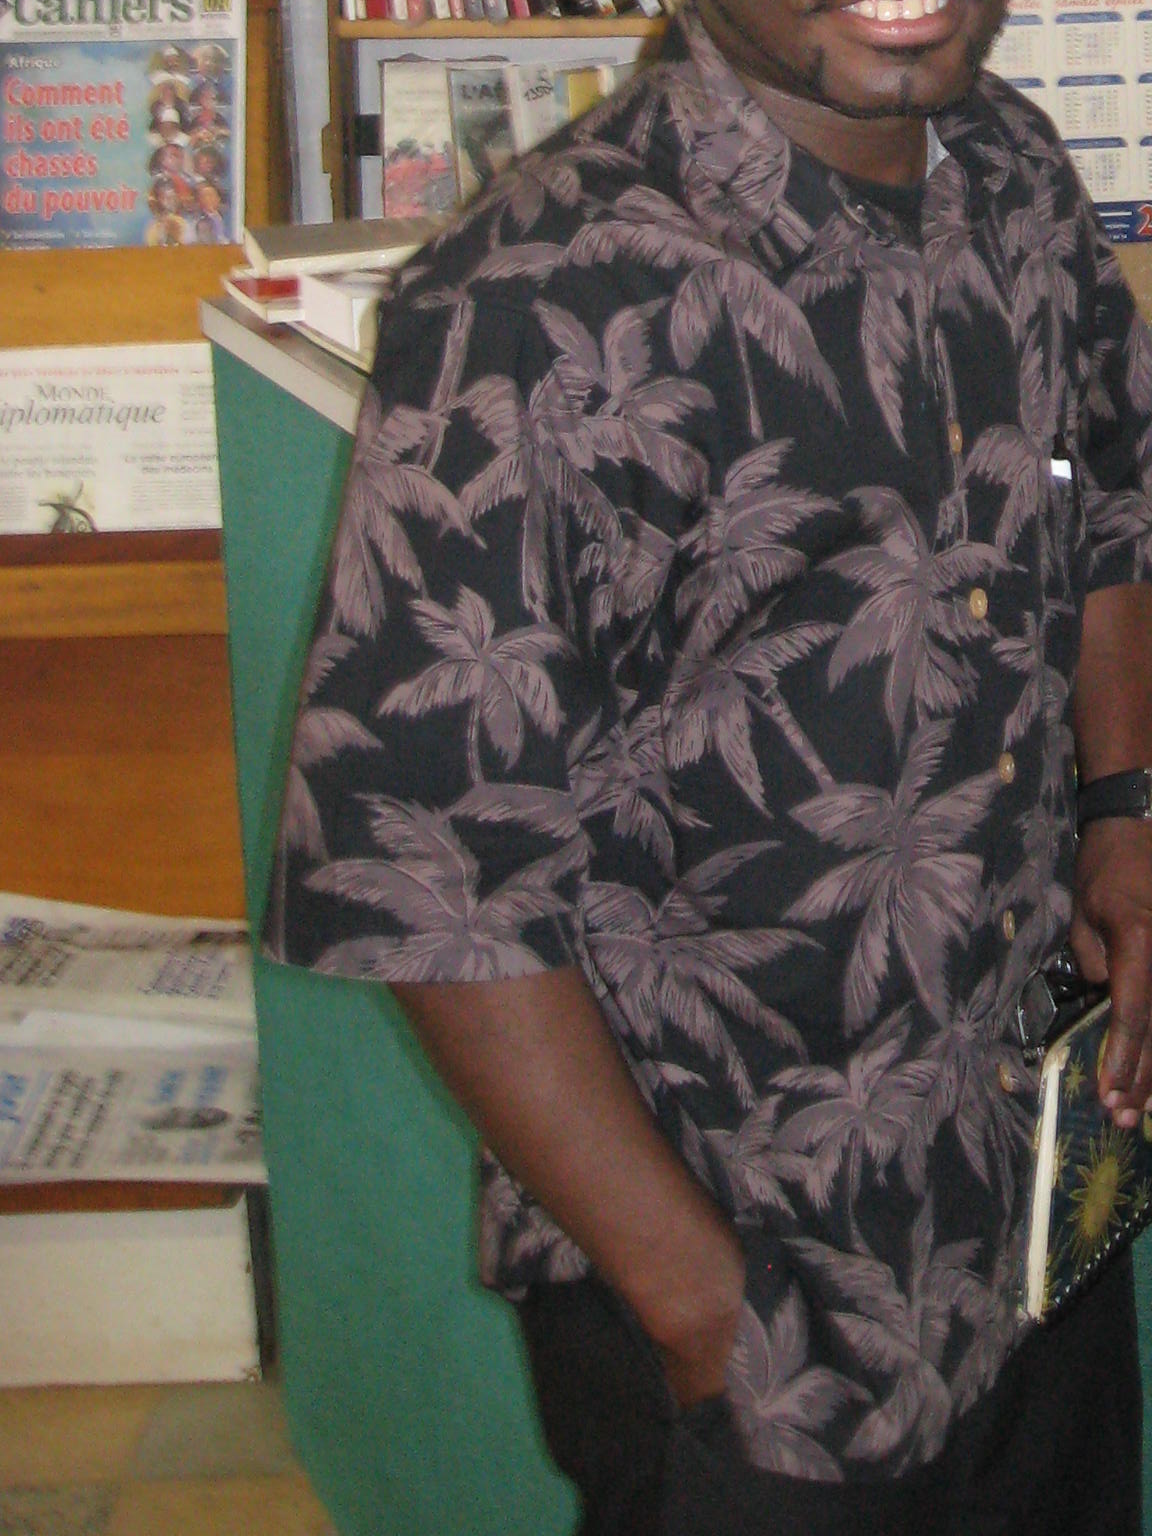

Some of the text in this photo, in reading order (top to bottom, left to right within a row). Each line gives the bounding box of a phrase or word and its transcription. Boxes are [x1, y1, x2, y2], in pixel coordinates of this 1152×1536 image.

[4, 75, 126, 107] Comment
[4, 112, 131, 144] ils ont été
[4, 147, 98, 180] chassés
[4, 182, 139, 222] du pouvoir
[36, 383, 112, 402] MONDE
[0, 398, 168, 434] iplomatique
